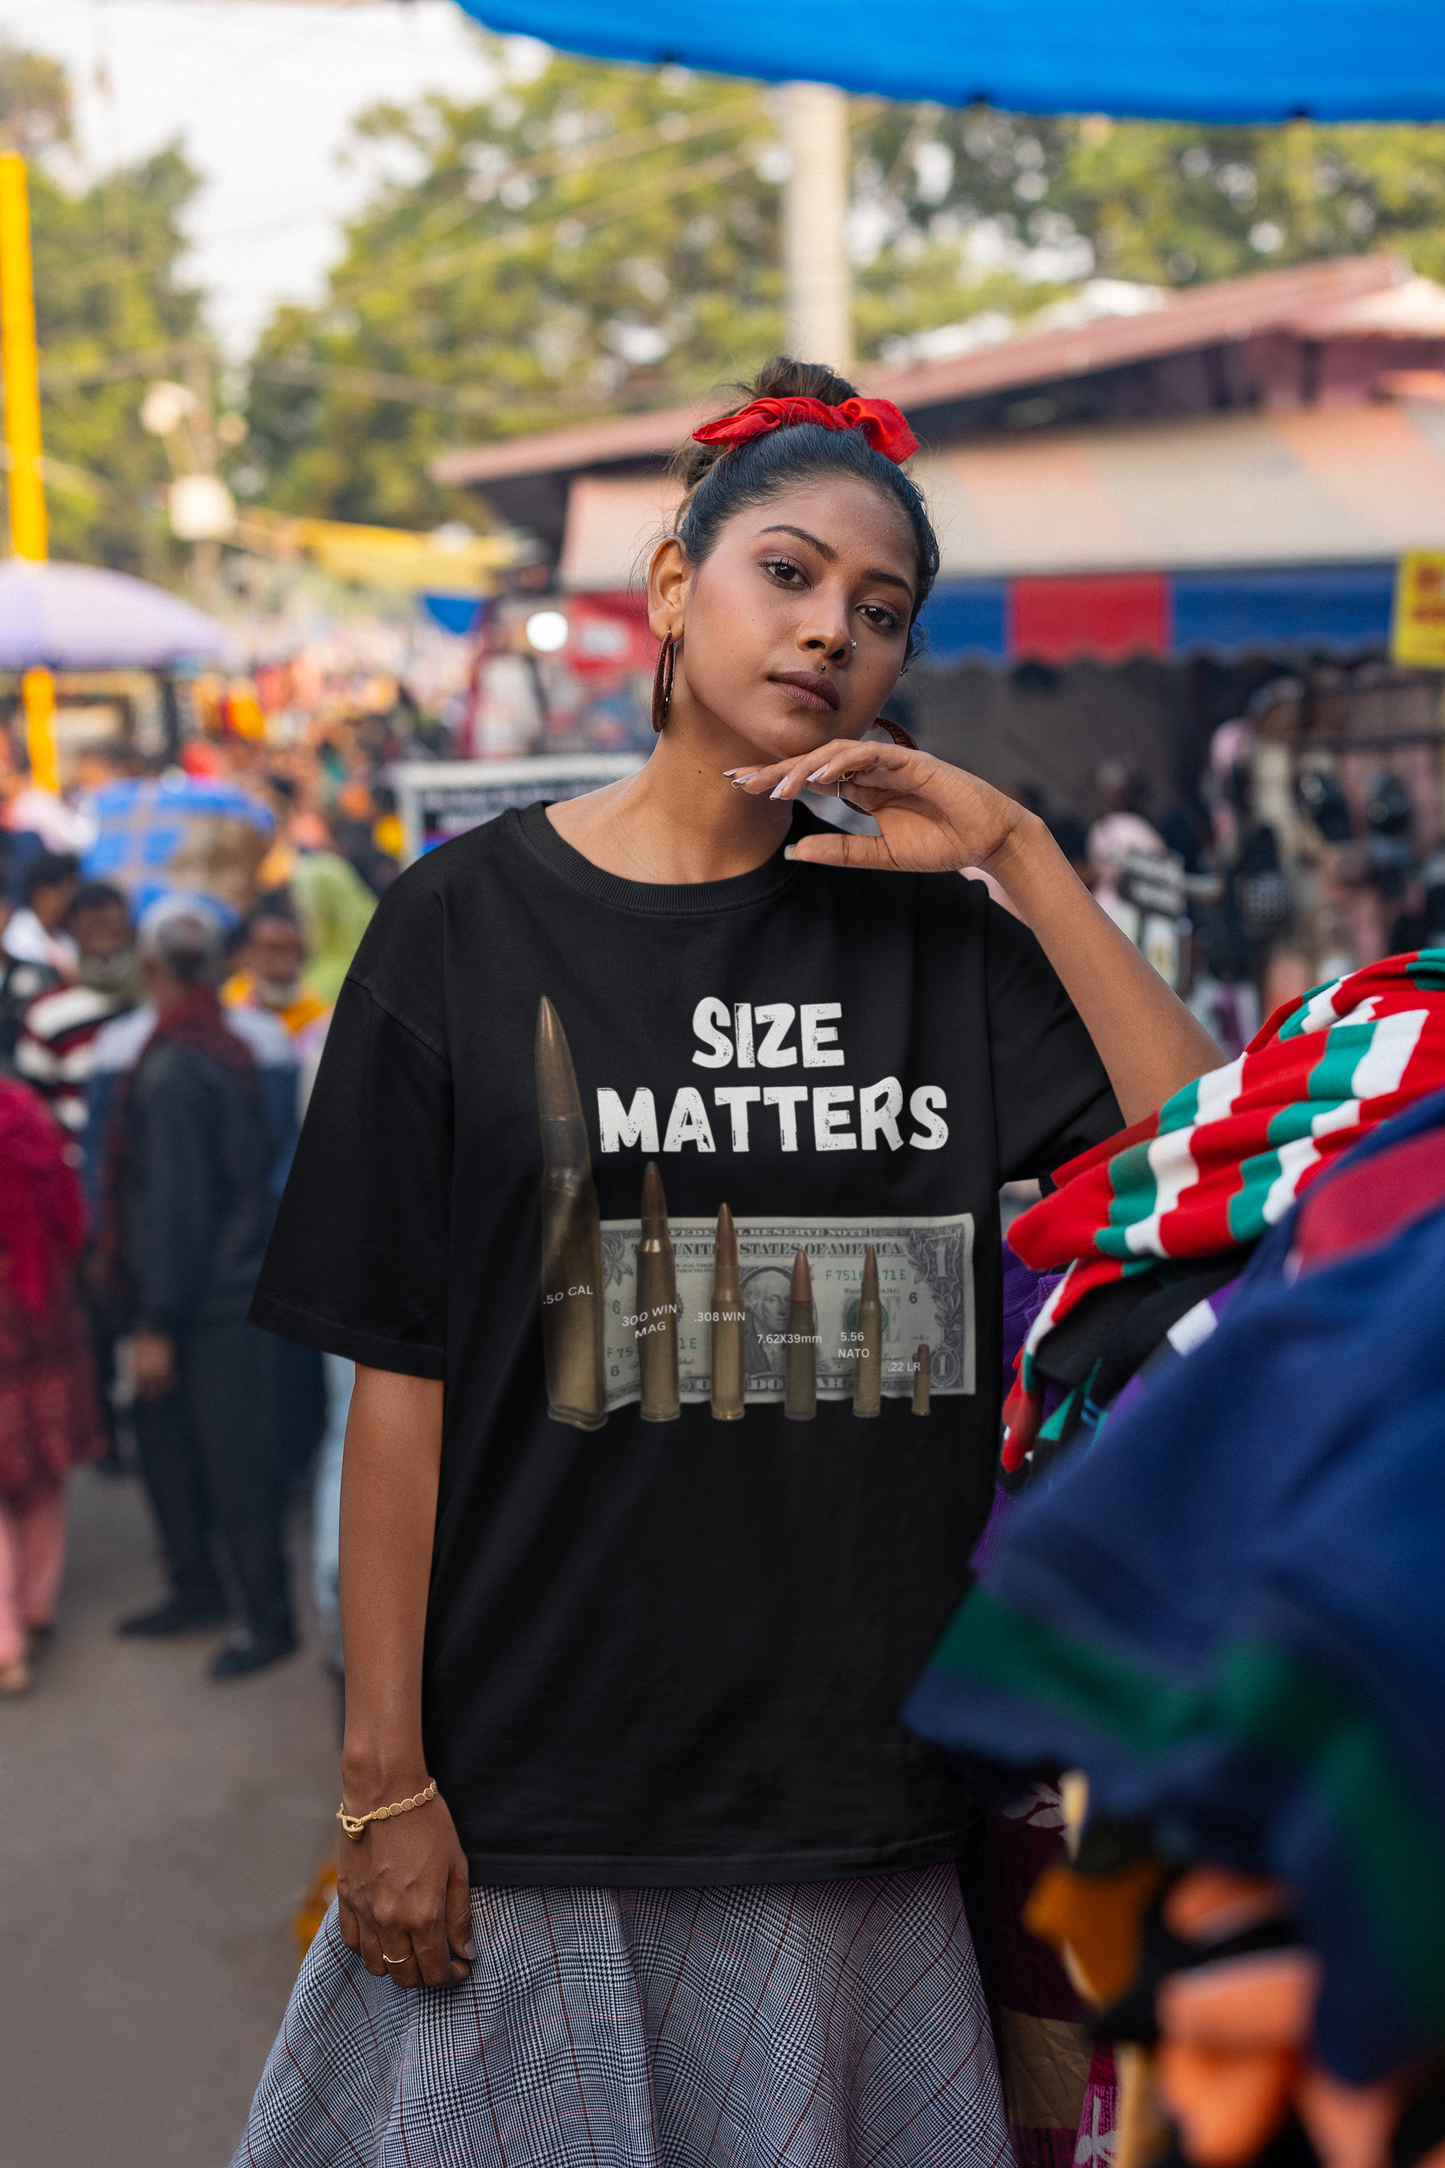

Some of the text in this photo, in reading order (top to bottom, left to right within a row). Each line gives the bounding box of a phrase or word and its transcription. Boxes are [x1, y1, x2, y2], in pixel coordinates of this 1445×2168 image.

[692, 996, 845, 1069] SIZE
[596, 1076, 949, 1153] MATTERS
[749, 1229, 825, 1237] RESERVE
[827, 1229, 868, 1237] NOTE
[739, 1242, 802, 1257] STATES
[804, 1242, 827, 1257] OF
[543, 1284, 594, 1305] .50 CAL
[621, 1303, 678, 1328] 300 WIN
[693, 1311, 746, 1322] .308 WIN
[634, 1321, 667, 1340] MAG
[840, 1331, 865, 1342] 5.56
[756, 1333, 823, 1345] 7.62X39mm
[837, 1348, 870, 1359] NATO
[888, 1361, 921, 1372] .22 LR
